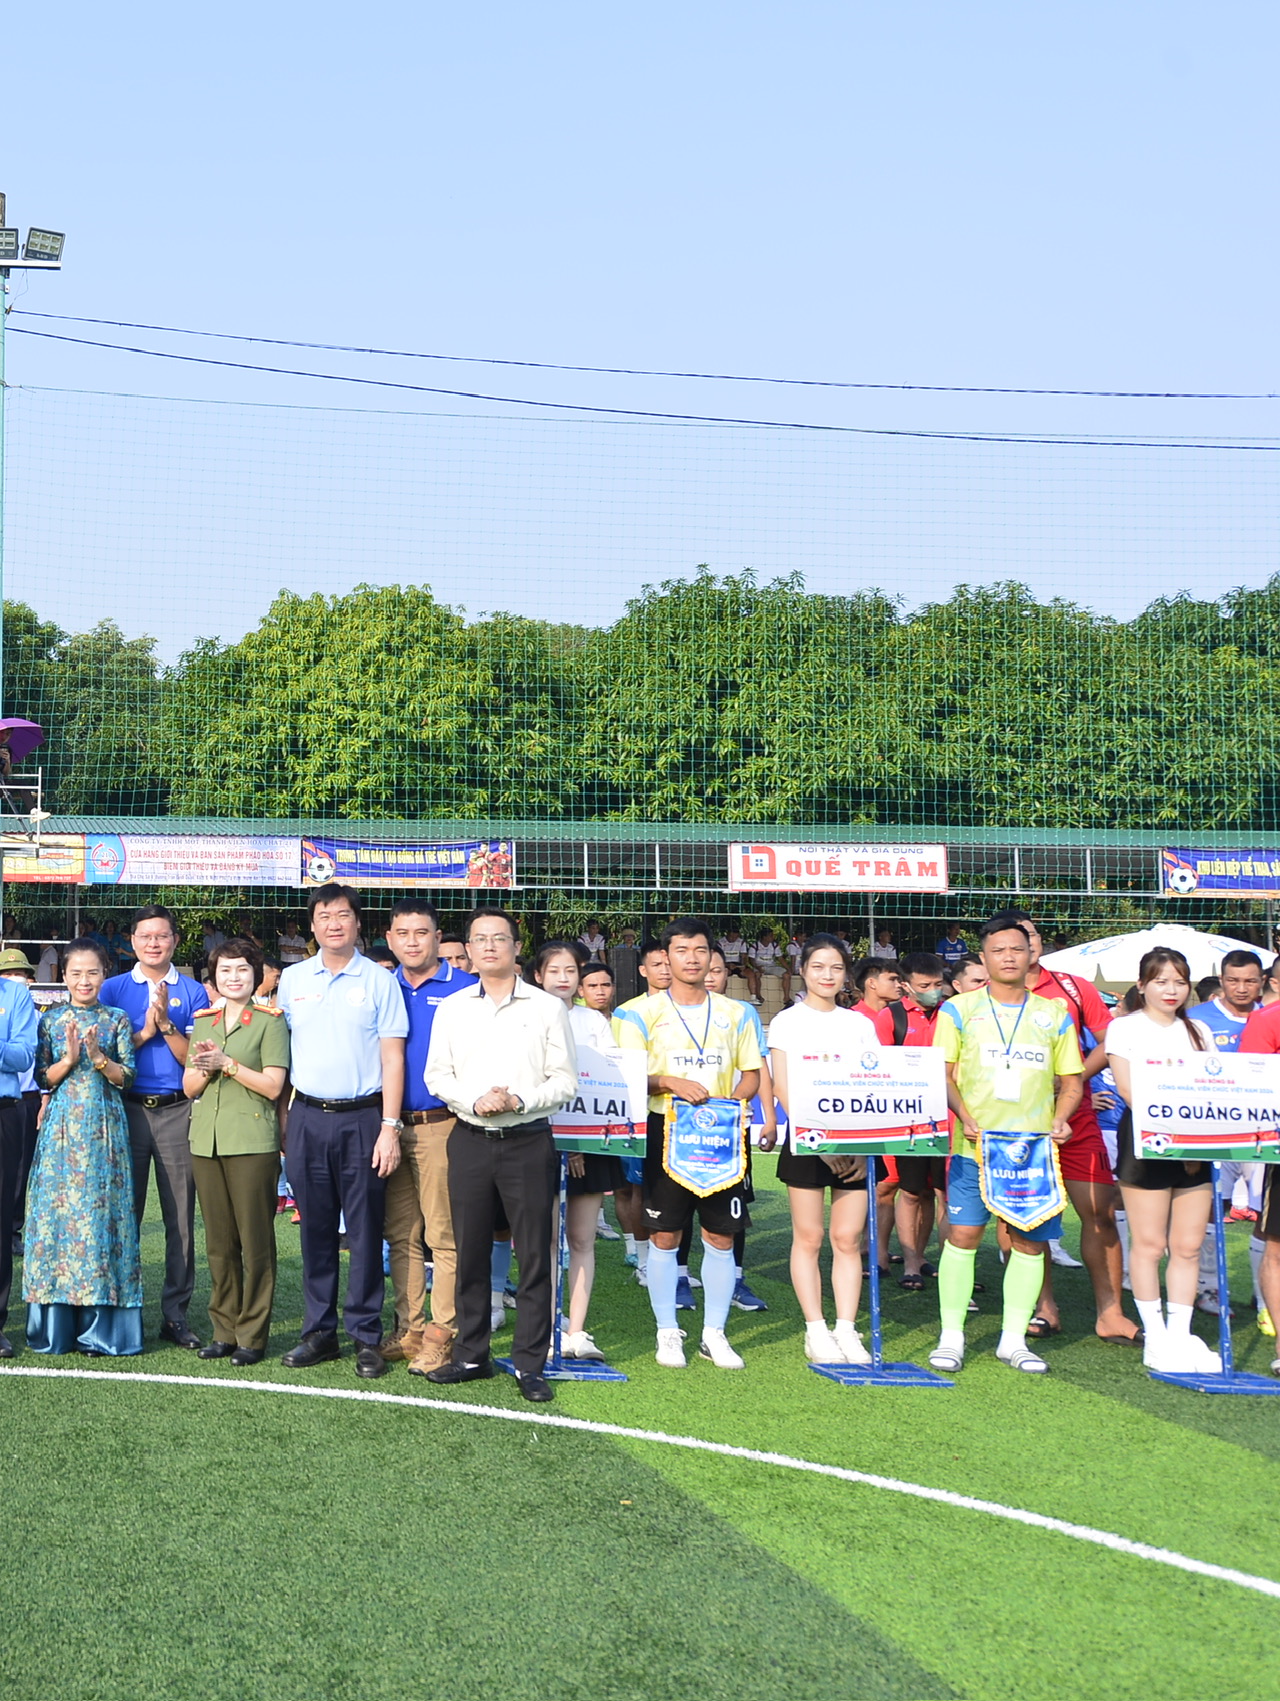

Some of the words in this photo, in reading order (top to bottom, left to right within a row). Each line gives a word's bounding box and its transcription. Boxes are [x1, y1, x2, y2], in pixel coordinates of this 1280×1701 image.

[853, 846, 869, 854] VÀ
[872, 846, 890, 854] GIA
[785, 855, 841, 877] QUẾ
[853, 857, 938, 877] TRÂM
[673, 1054, 723, 1066] THACO
[580, 1070, 590, 1078] ĐÁ
[584, 1079, 597, 1087] VIỆT
[886, 1080, 899, 1088] VIỆT
[558, 1096, 587, 1114] IA
[594, 1098, 626, 1117] LAI
[818, 1098, 845, 1113] CĐ
[851, 1093, 888, 1114] DẦU
[894, 1095, 923, 1114] KHÍ
[1148, 1104, 1173, 1118] CĐ
[1178, 1101, 1242, 1121] QUẢNG
[679, 1134, 701, 1145] LƯU
[702, 1135, 730, 1149] NIỆM
